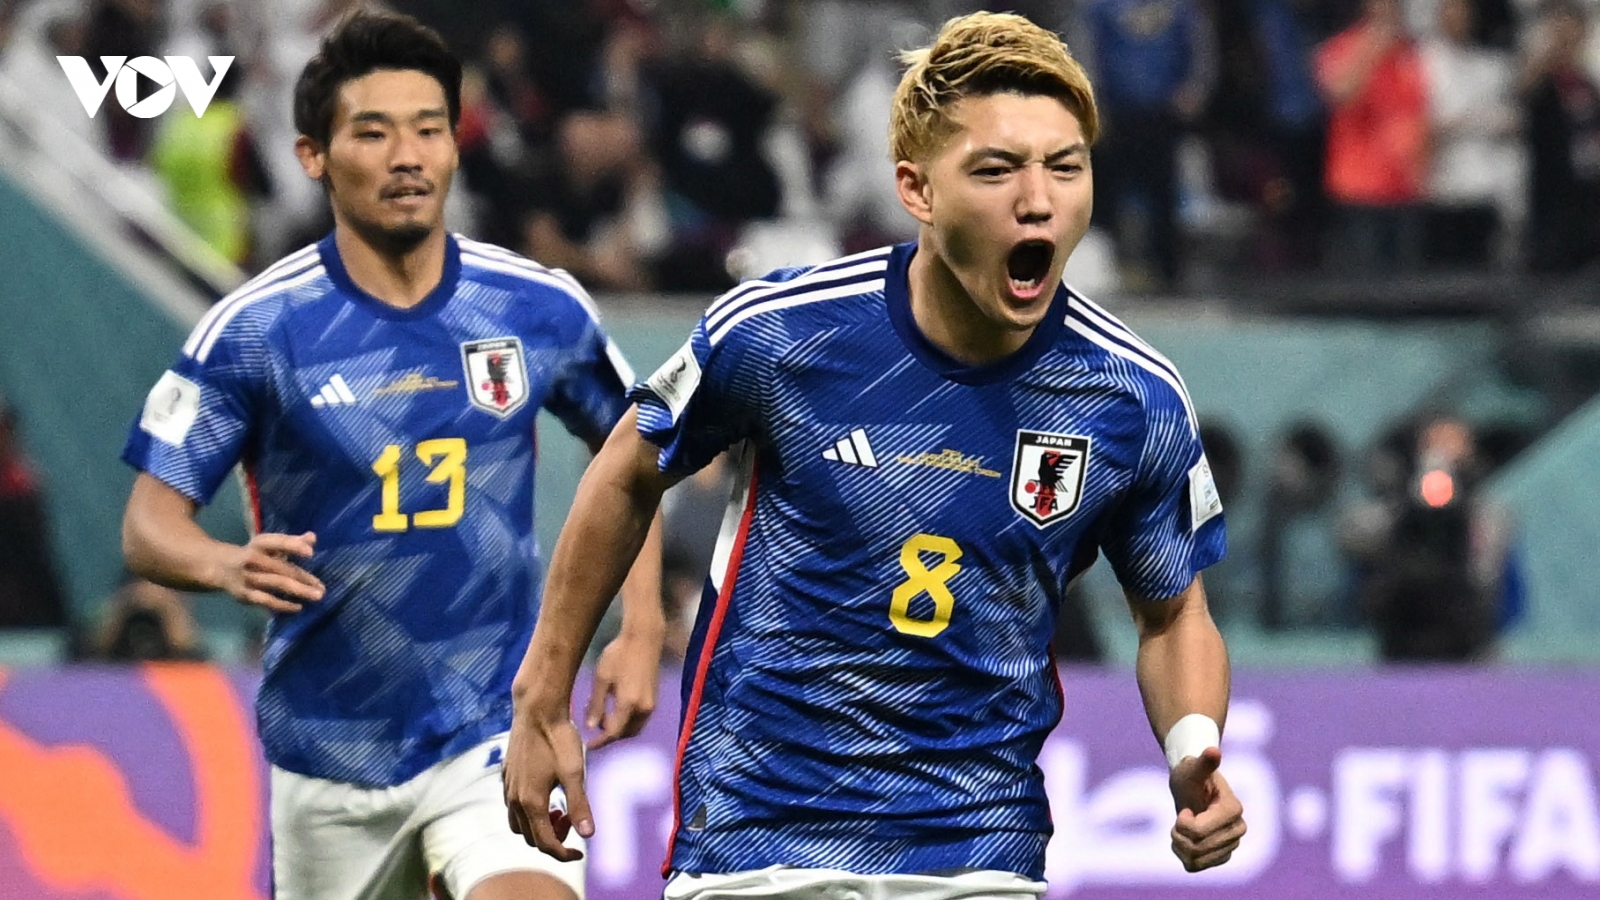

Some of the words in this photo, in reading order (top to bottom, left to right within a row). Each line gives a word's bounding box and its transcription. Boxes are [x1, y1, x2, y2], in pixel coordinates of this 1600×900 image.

[372, 437, 467, 531] 13
[1035, 435, 1072, 447] JAPAN
[1028, 496, 1058, 511] JFA
[888, 533, 963, 638] 8
[1331, 747, 1600, 884] FIFA
